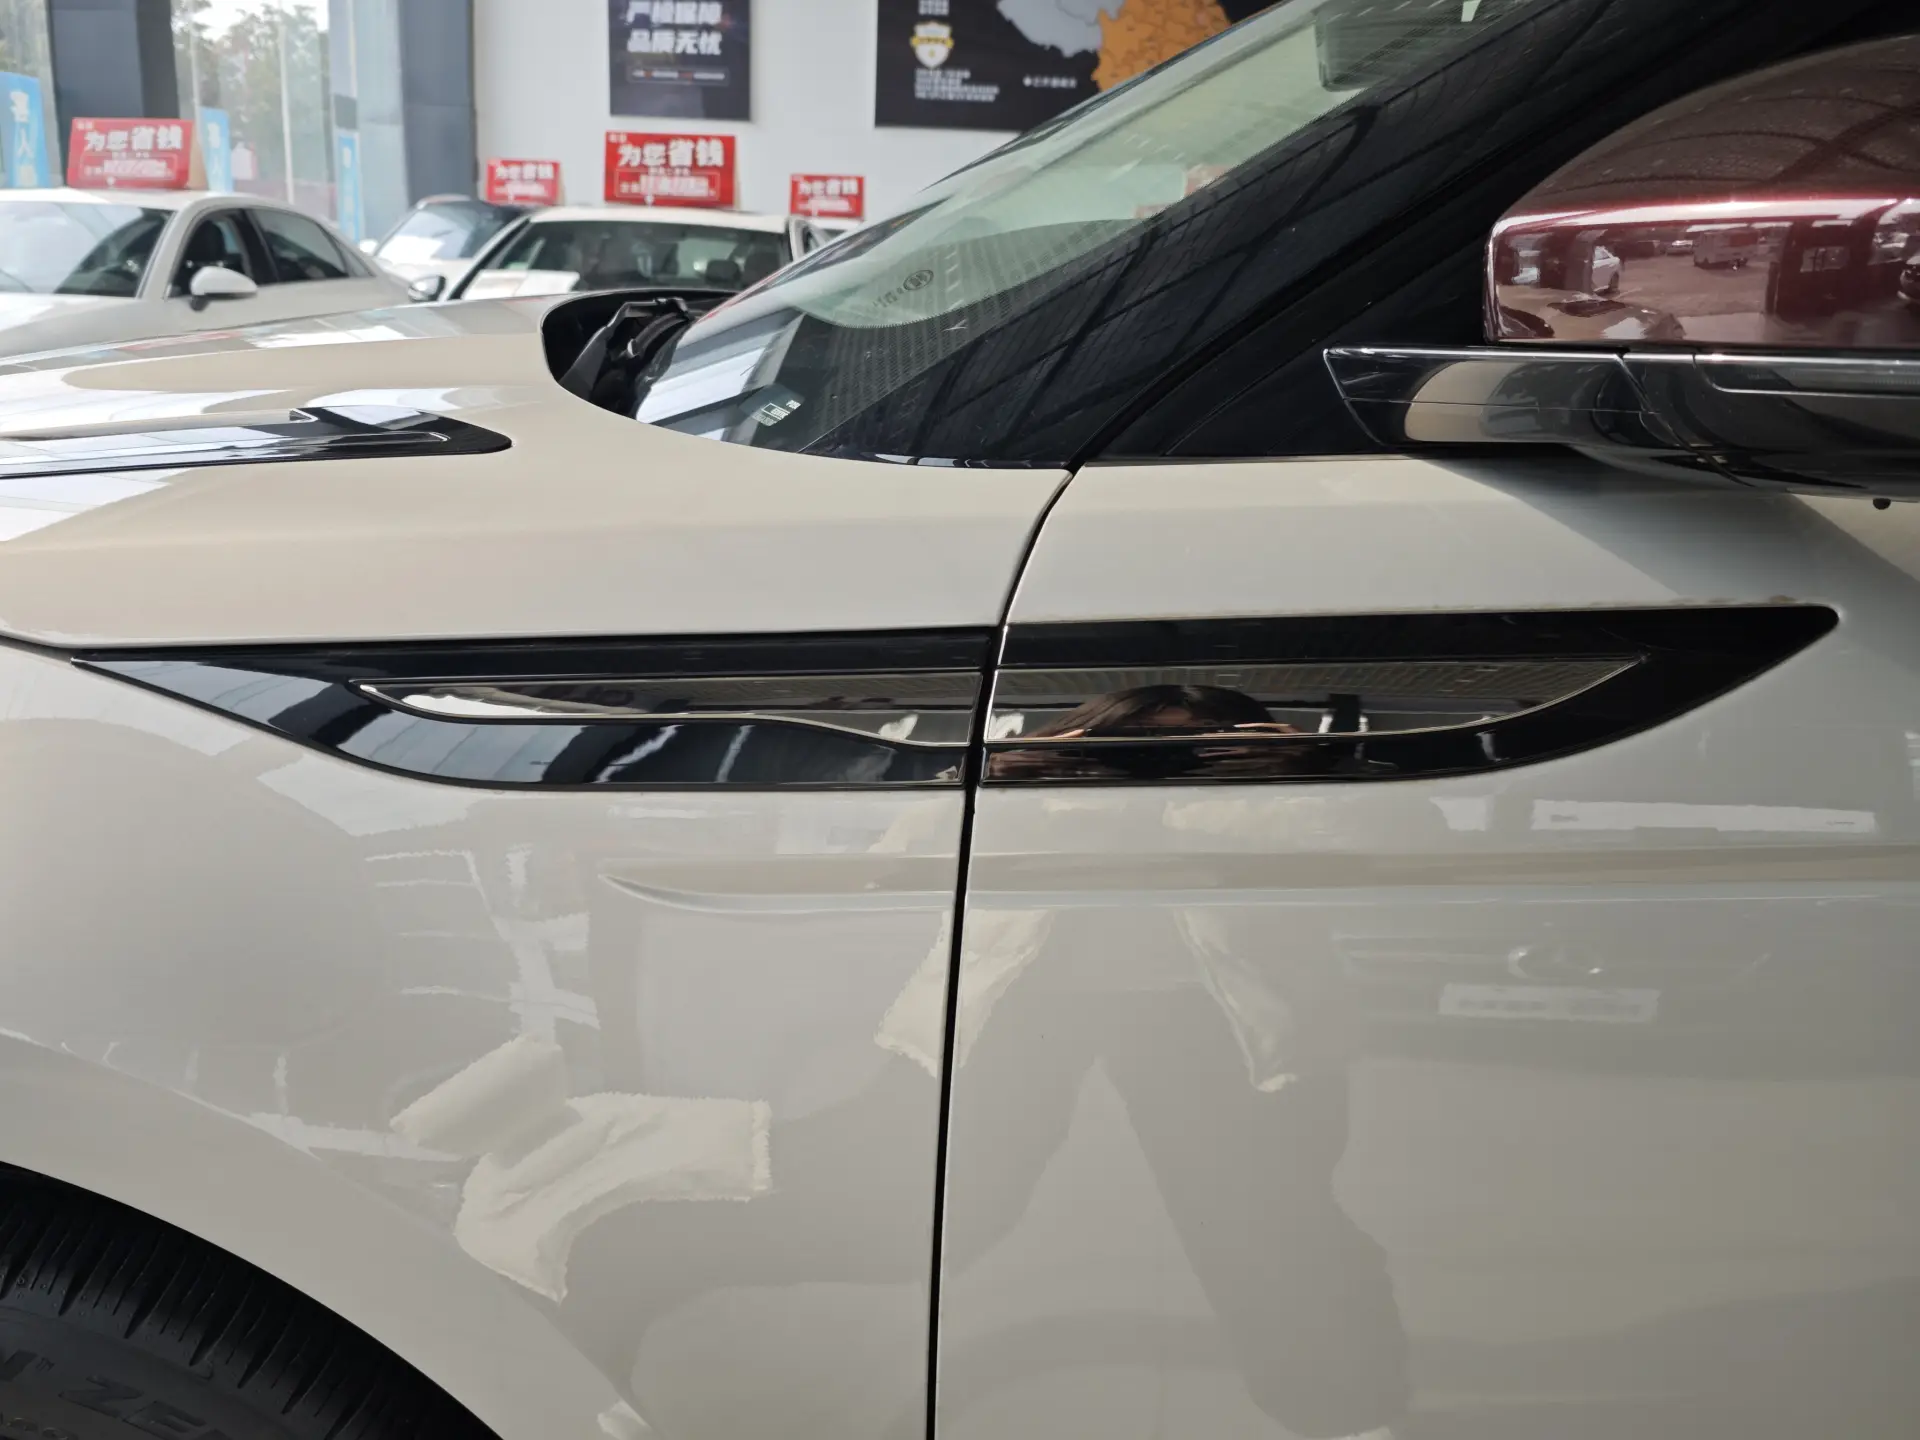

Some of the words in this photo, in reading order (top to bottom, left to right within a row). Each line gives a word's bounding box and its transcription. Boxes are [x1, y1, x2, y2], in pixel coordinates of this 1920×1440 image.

[627, 30, 722, 55] 品质无忧
[84, 124, 184, 152] 为您省钱
[618, 138, 725, 168] 为您省钱
